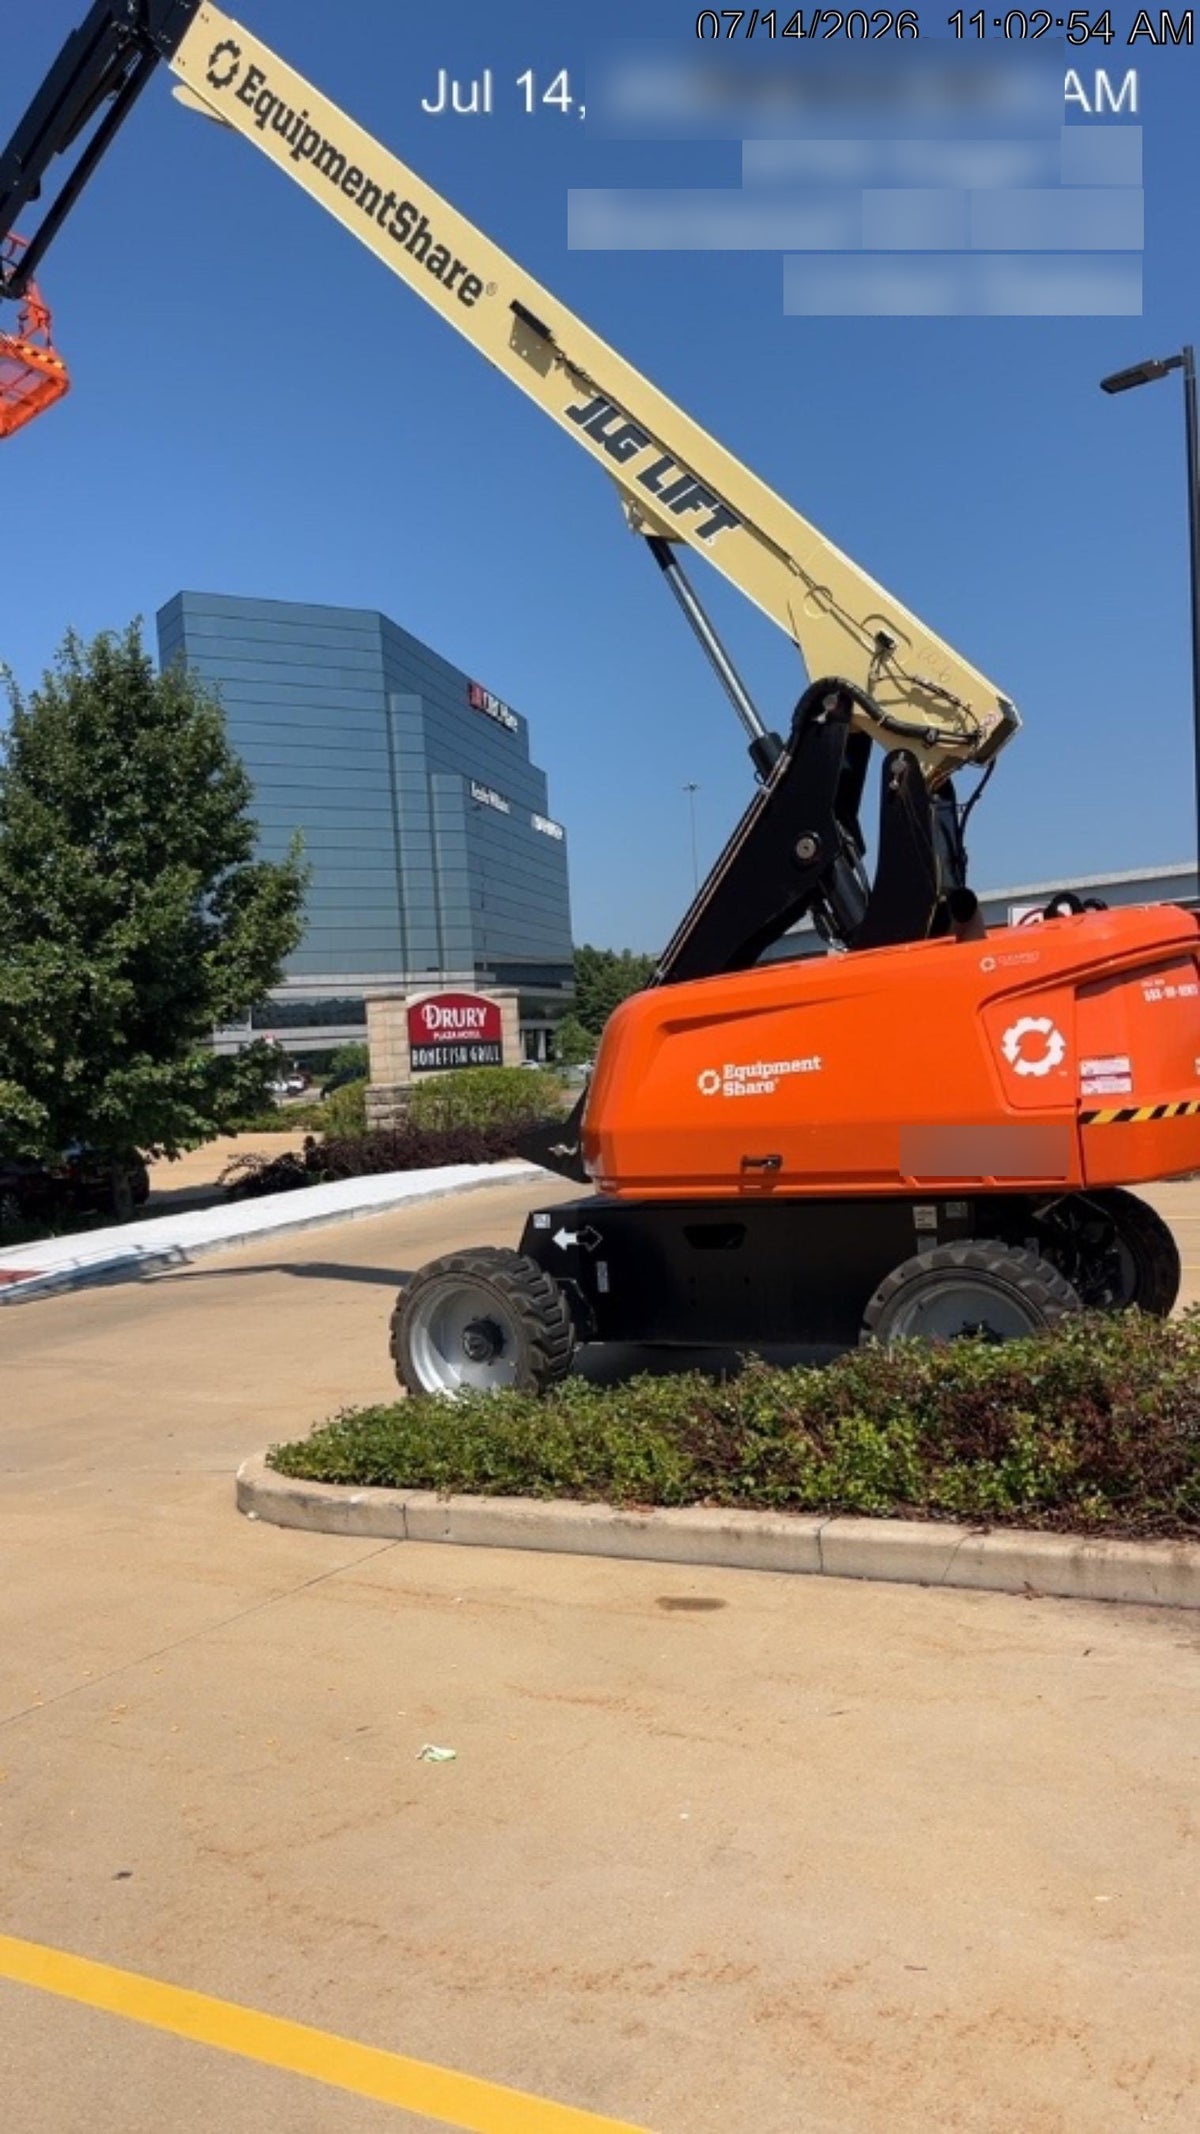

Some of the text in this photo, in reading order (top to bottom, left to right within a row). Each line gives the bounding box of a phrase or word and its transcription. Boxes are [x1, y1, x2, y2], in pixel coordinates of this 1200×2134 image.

[564, 395, 741, 540] JLG LIFT
[421, 1004, 487, 1030] DRURY
[411, 1045, 500, 1068] BONEFISH GRILL
[723, 1056, 822, 1081] Equipment
[723, 1079, 776, 1097] Share
